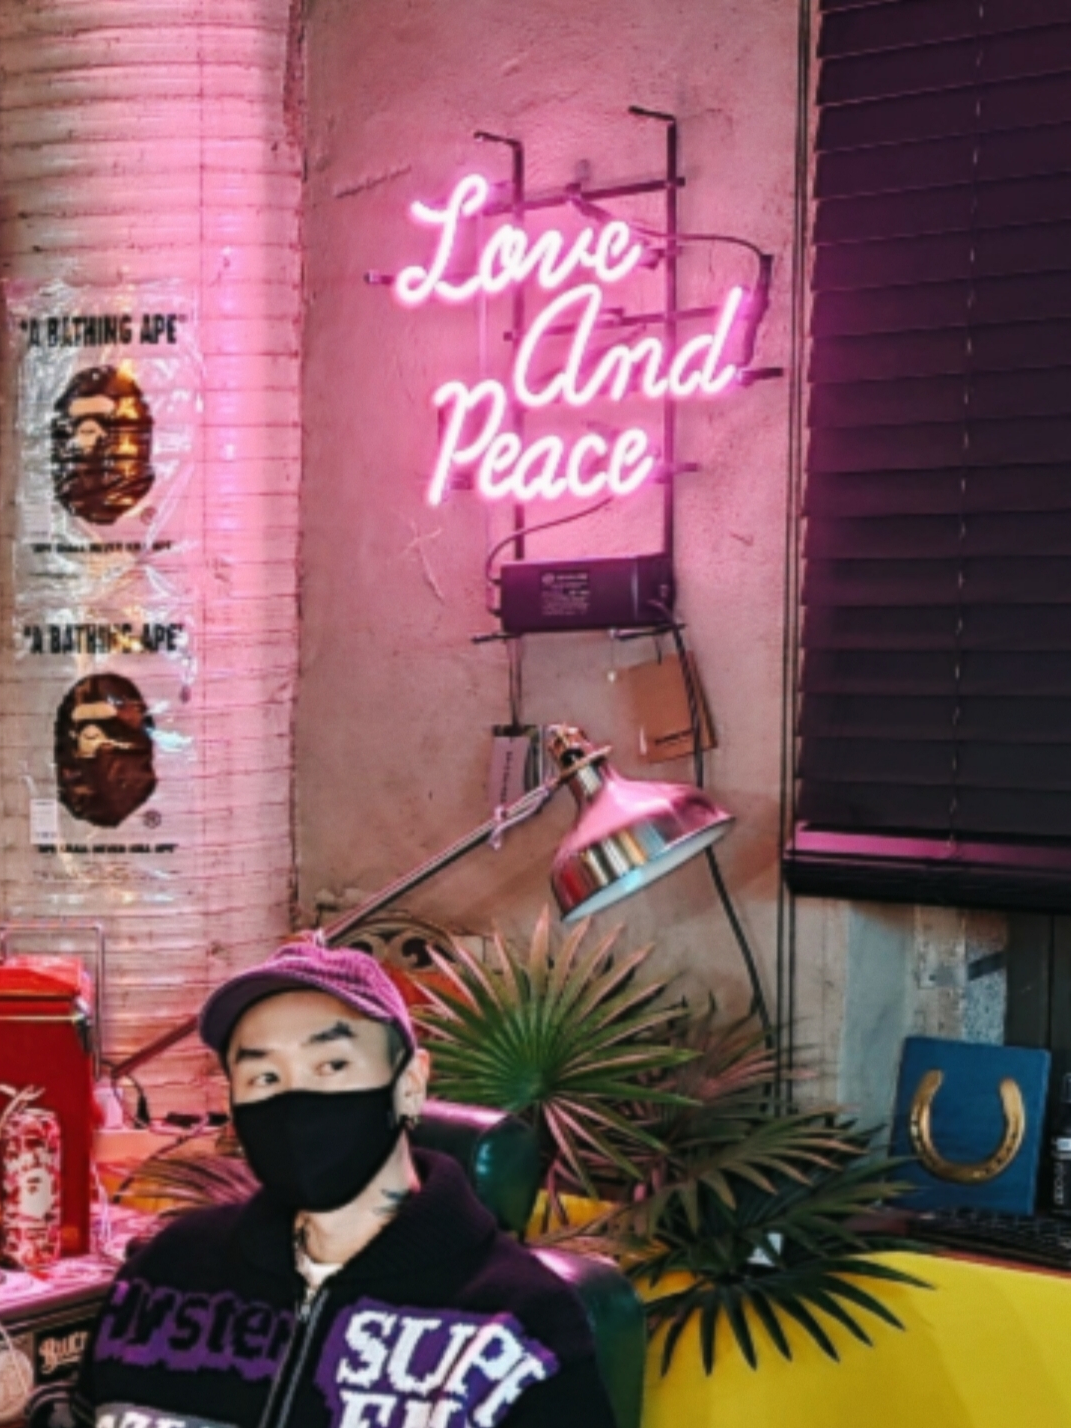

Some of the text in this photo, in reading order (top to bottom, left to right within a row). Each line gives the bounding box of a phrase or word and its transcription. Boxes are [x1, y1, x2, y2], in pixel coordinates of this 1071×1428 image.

[394, 172, 642, 301] Love
[47, 315, 133, 348] BATHING
[512, 283, 744, 408] And
[426, 379, 655, 507] Peace
